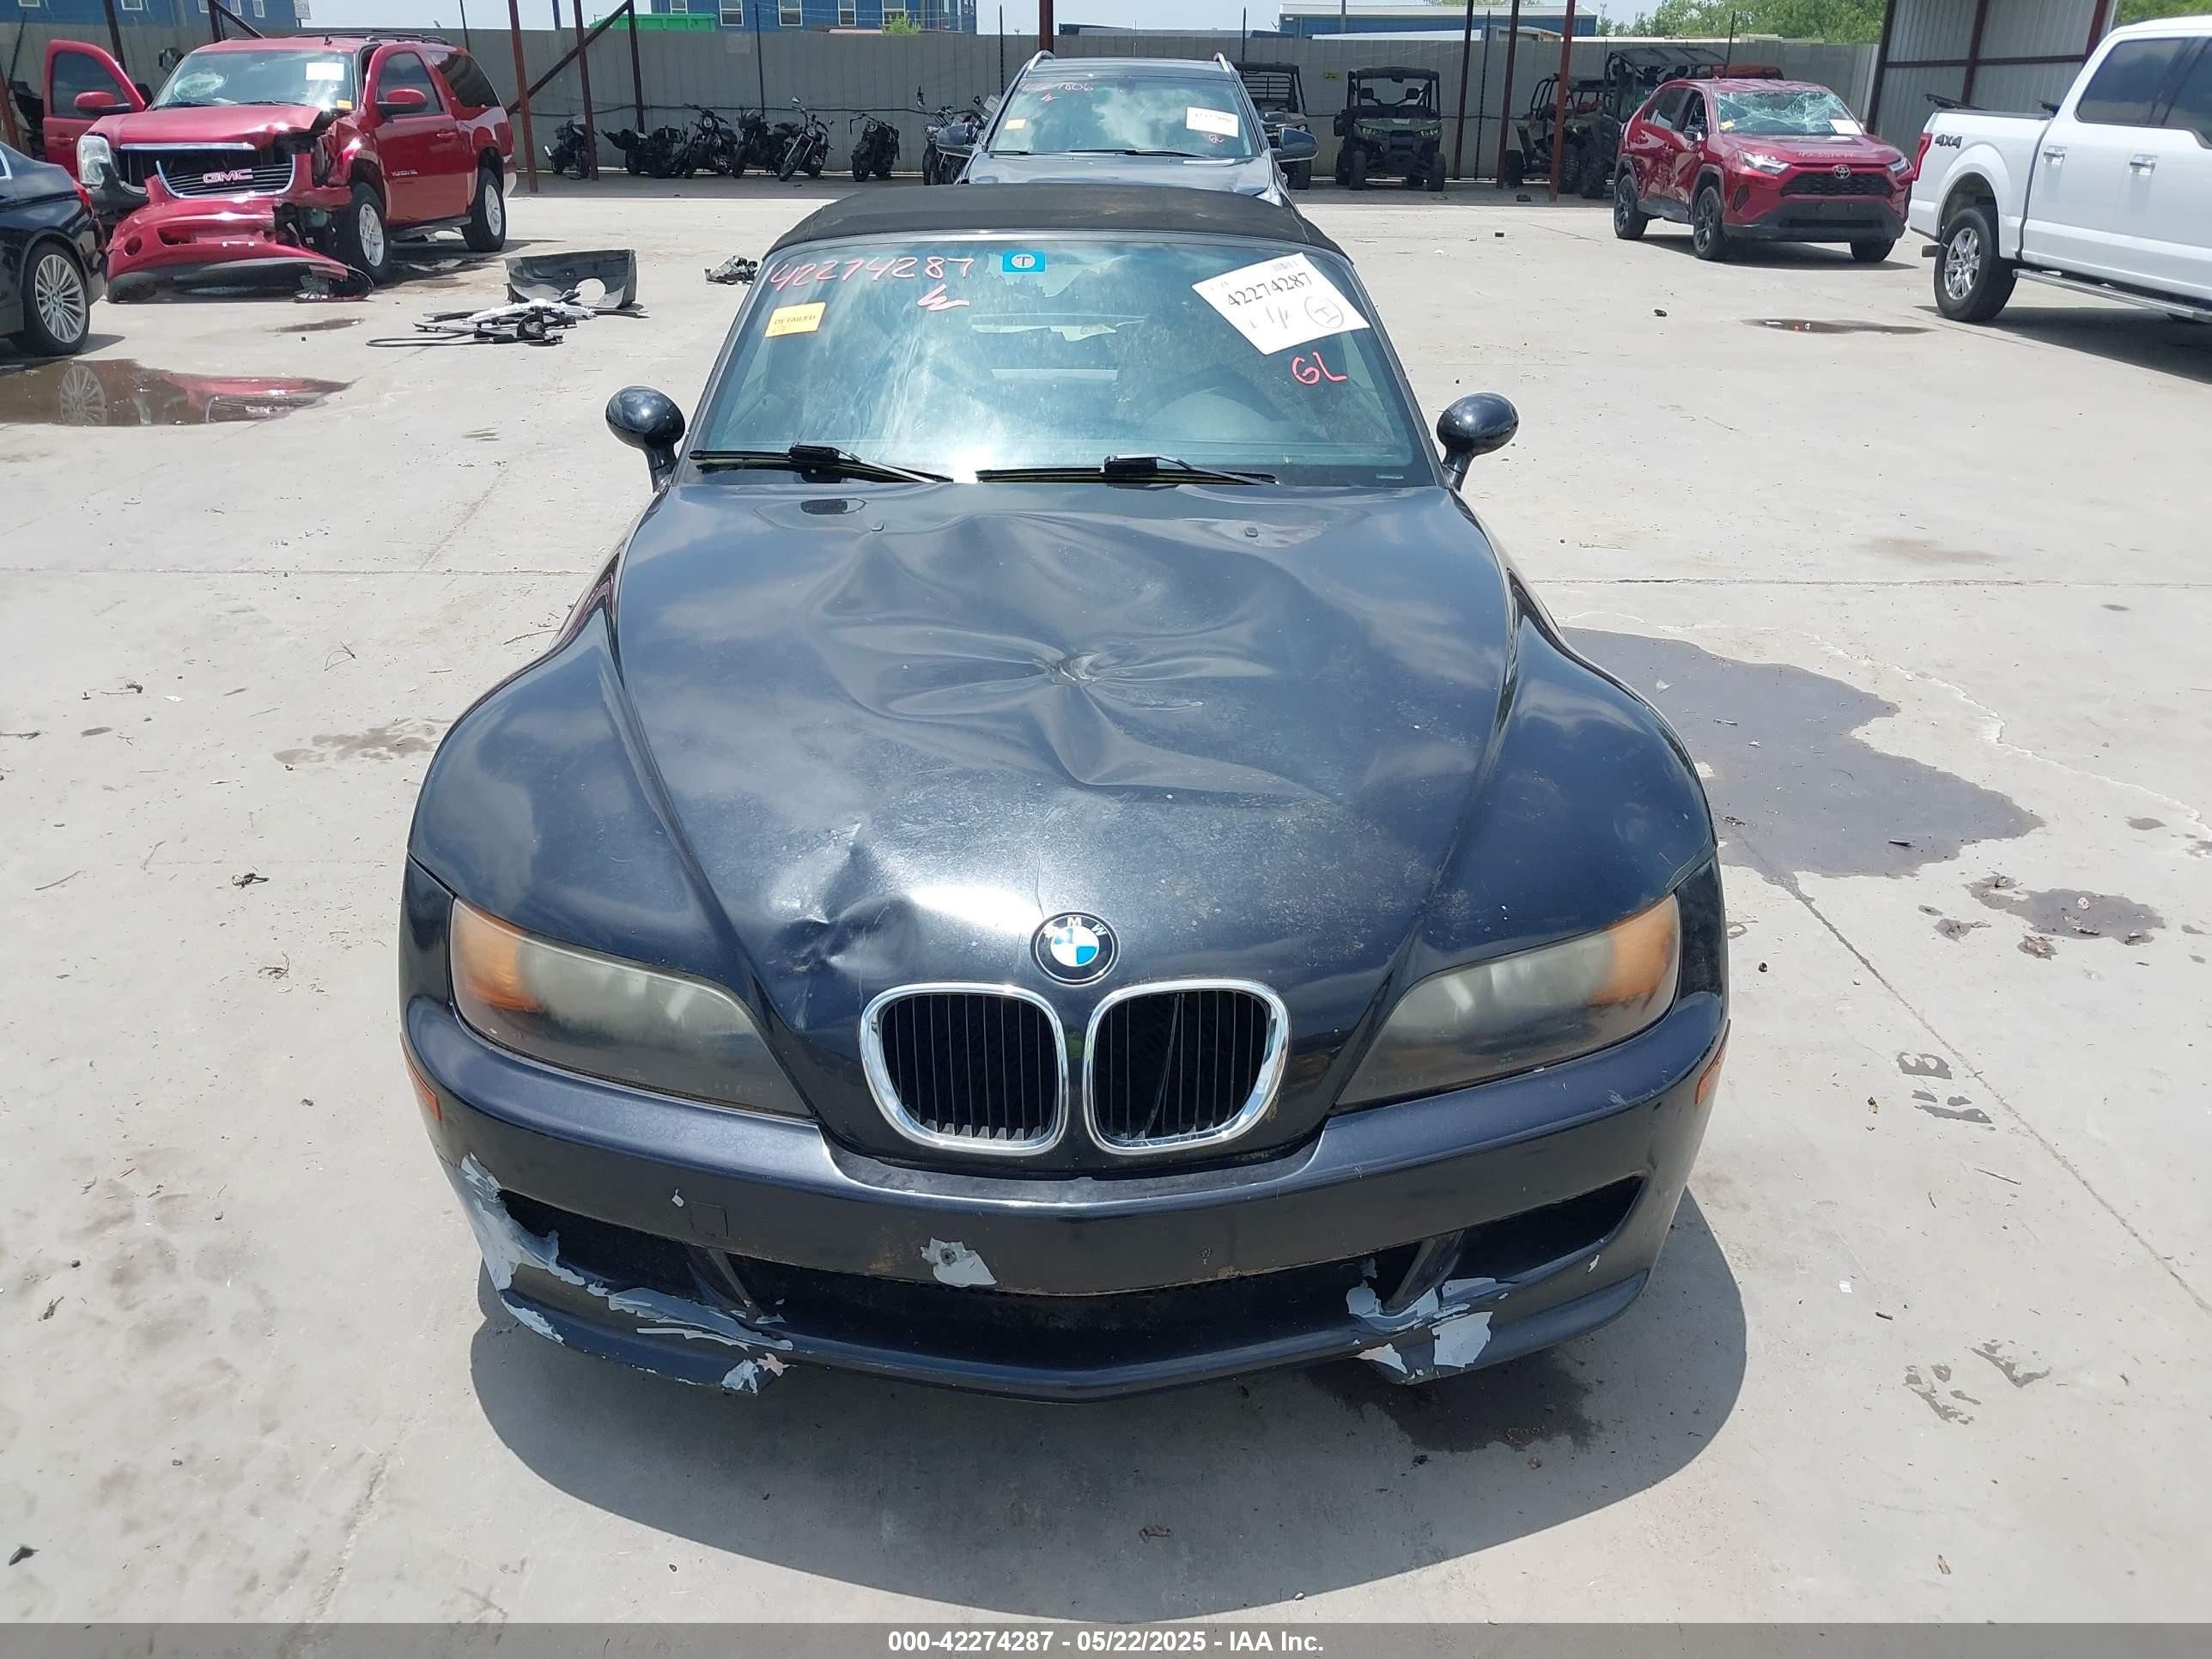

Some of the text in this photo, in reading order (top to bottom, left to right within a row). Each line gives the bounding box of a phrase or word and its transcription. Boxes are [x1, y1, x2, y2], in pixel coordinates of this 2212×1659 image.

[203, 168, 254, 184] GMC
[770, 256, 975, 292] 42274287
[1226, 271, 1313, 307] 42274287
[774, 314, 817, 325] DETAILED
[1291, 350, 1348, 385] GL
